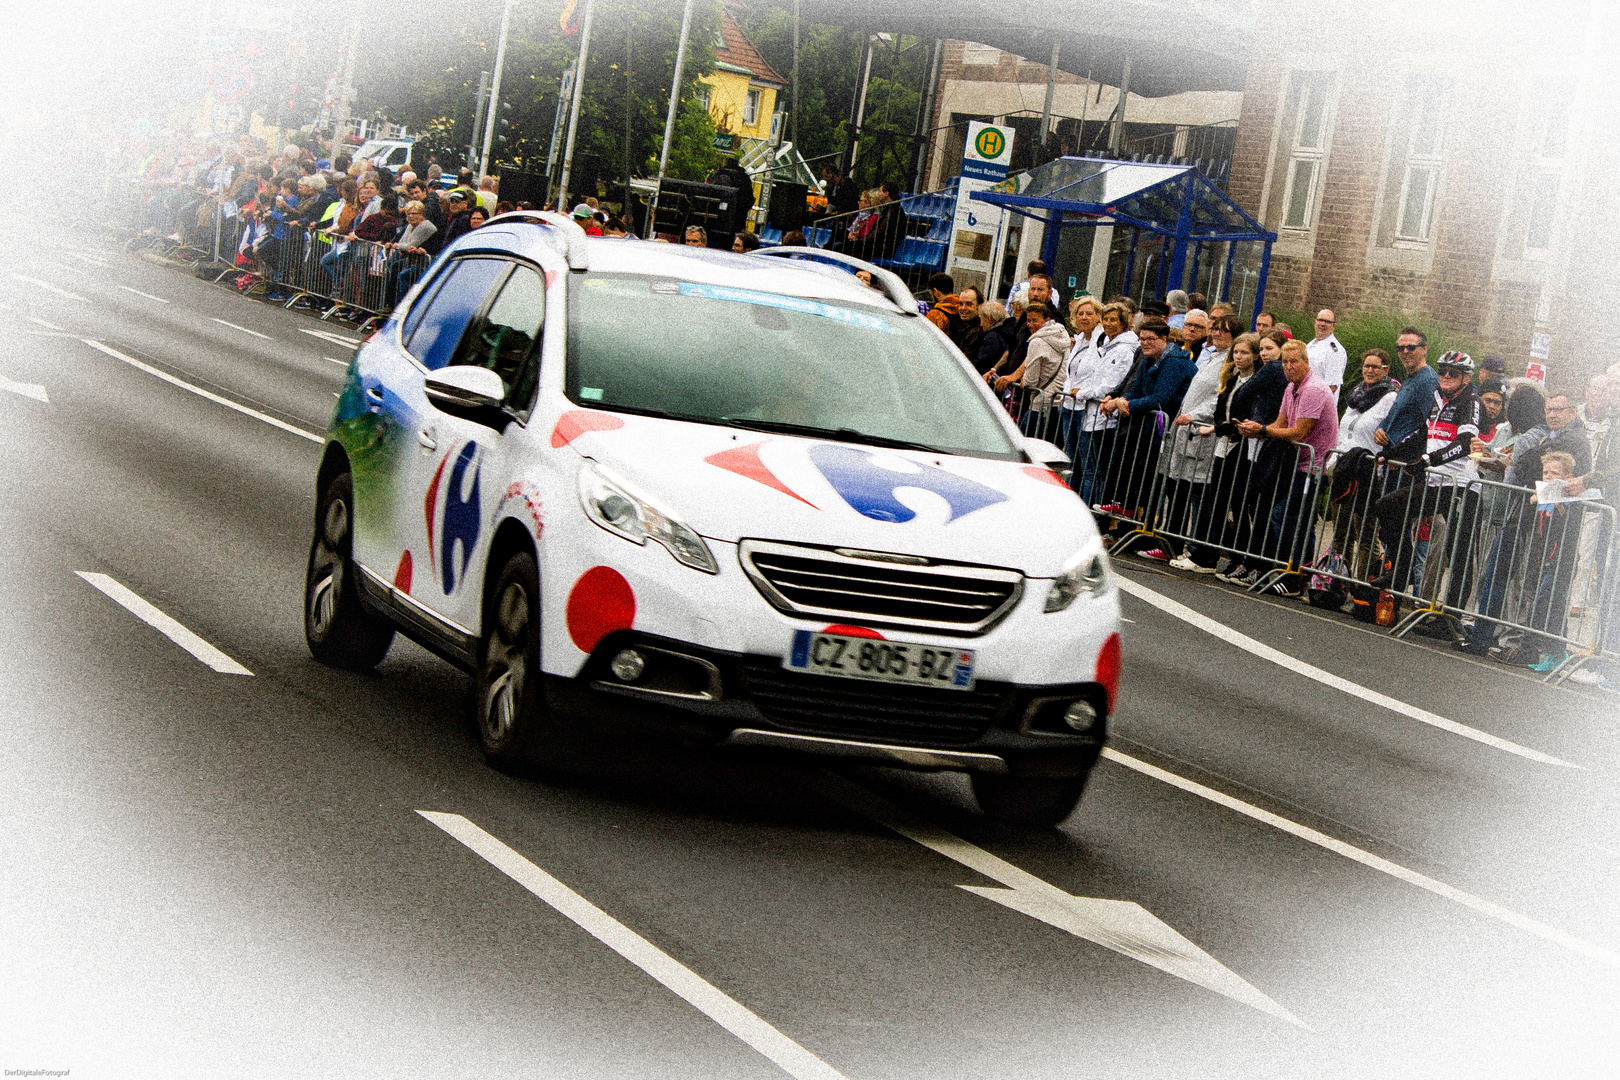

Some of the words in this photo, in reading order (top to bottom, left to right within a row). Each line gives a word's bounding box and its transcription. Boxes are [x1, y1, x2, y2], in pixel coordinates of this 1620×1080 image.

[983, 134, 998, 153] H
[964, 165, 982, 174] Neues
[983, 168, 1006, 178] Rathaus
